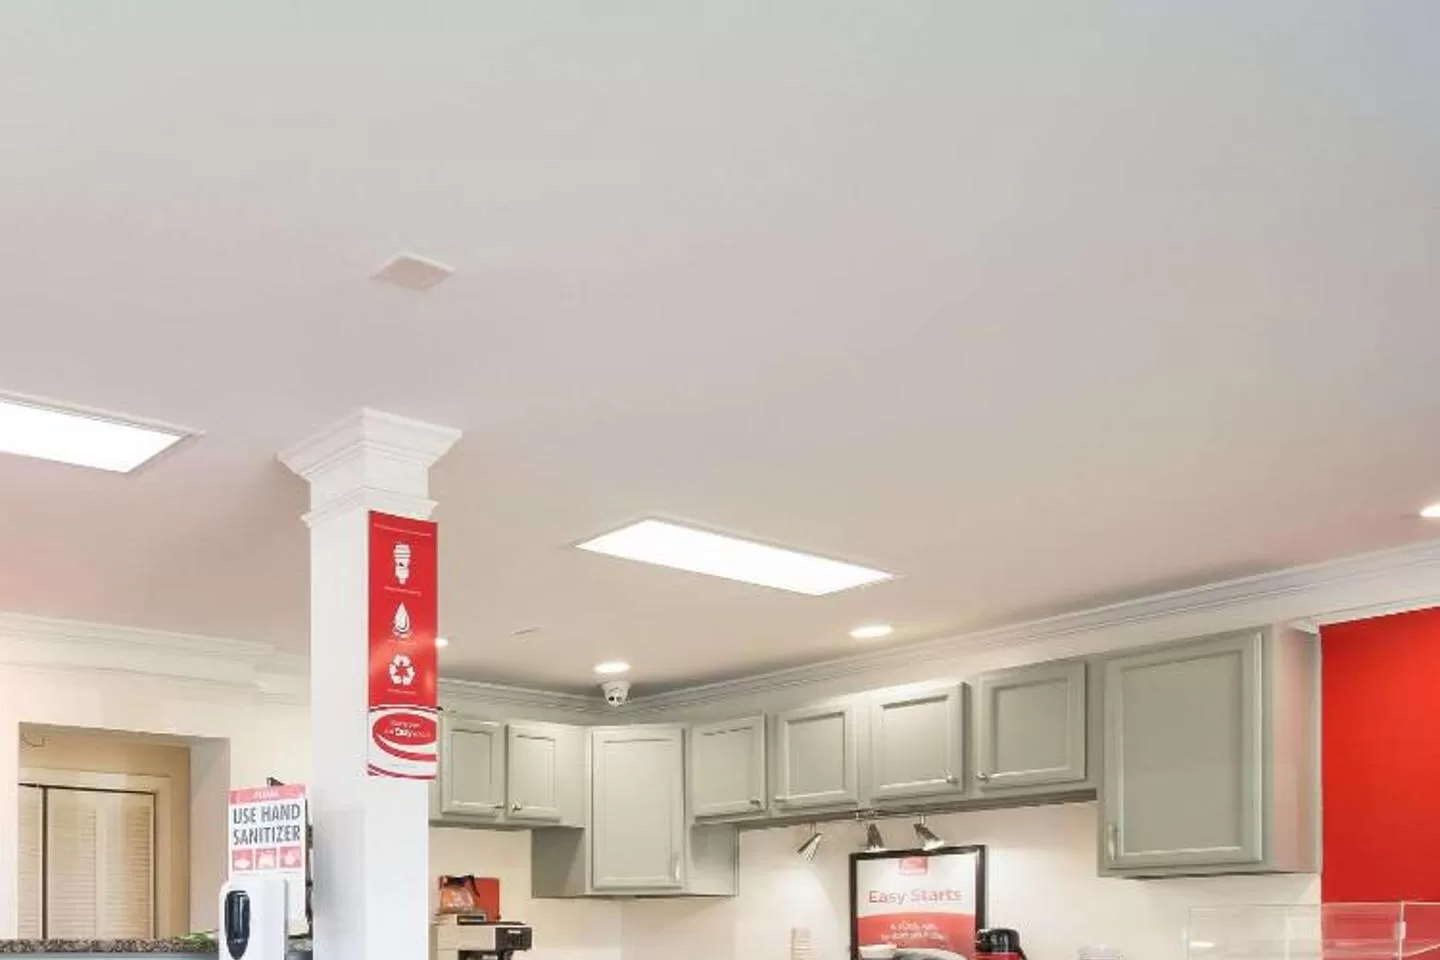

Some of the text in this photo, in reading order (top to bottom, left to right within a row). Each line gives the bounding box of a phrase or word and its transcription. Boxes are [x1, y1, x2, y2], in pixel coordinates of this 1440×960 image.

[233, 803, 301, 824] USE HAND
[232, 824, 301, 846] SANITIZER
[869, 888, 964, 906] Easy Starts
